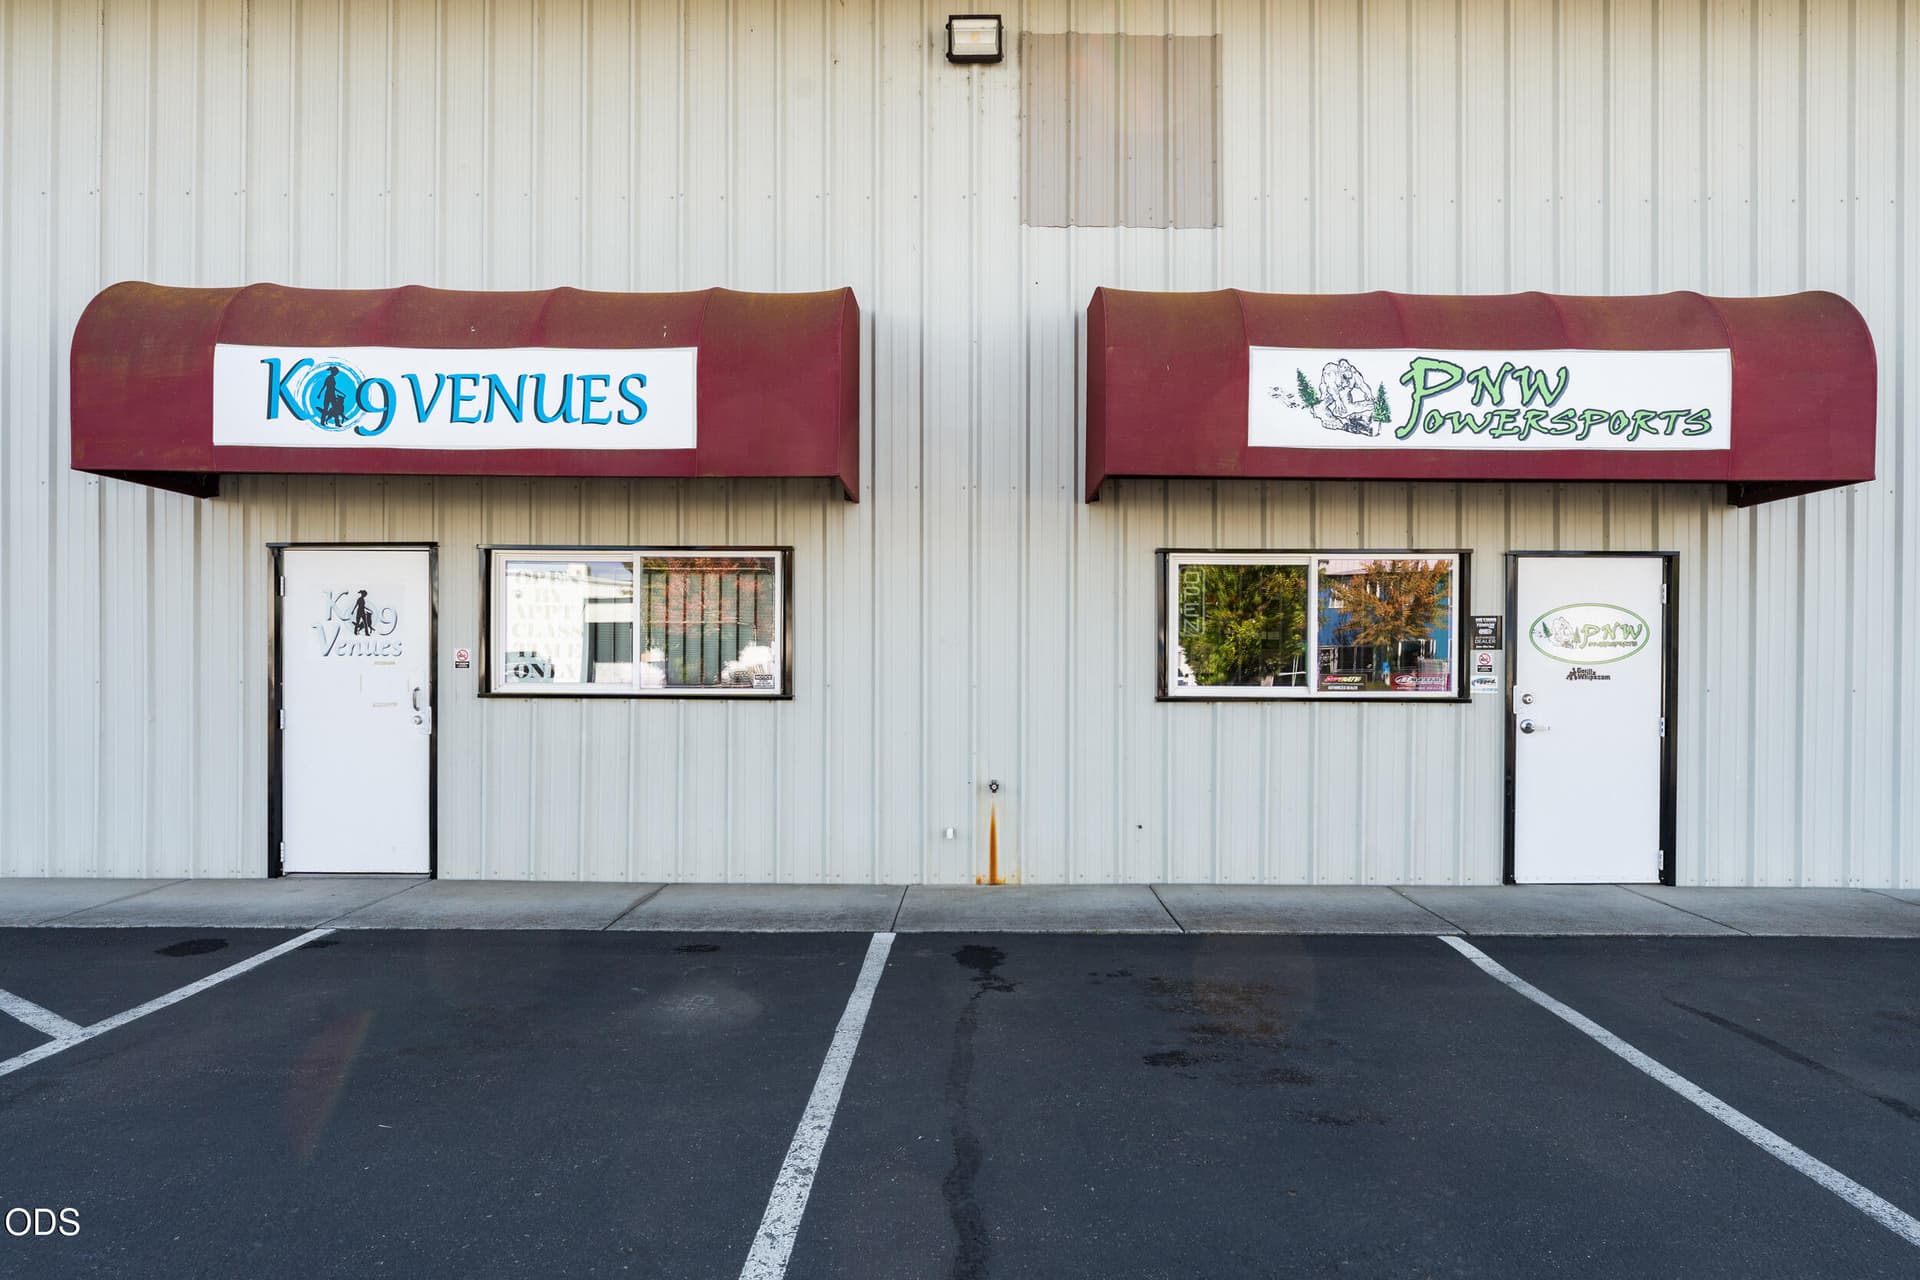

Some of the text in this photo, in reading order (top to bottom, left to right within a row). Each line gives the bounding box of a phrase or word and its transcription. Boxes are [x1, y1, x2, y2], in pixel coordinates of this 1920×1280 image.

[401, 373, 648, 425] VENUES
[1396, 356, 1569, 441] PNW
[1183, 571, 1201, 634] OPEN
[312, 623, 404, 657] Venues
[1579, 621, 1643, 649] PNW
